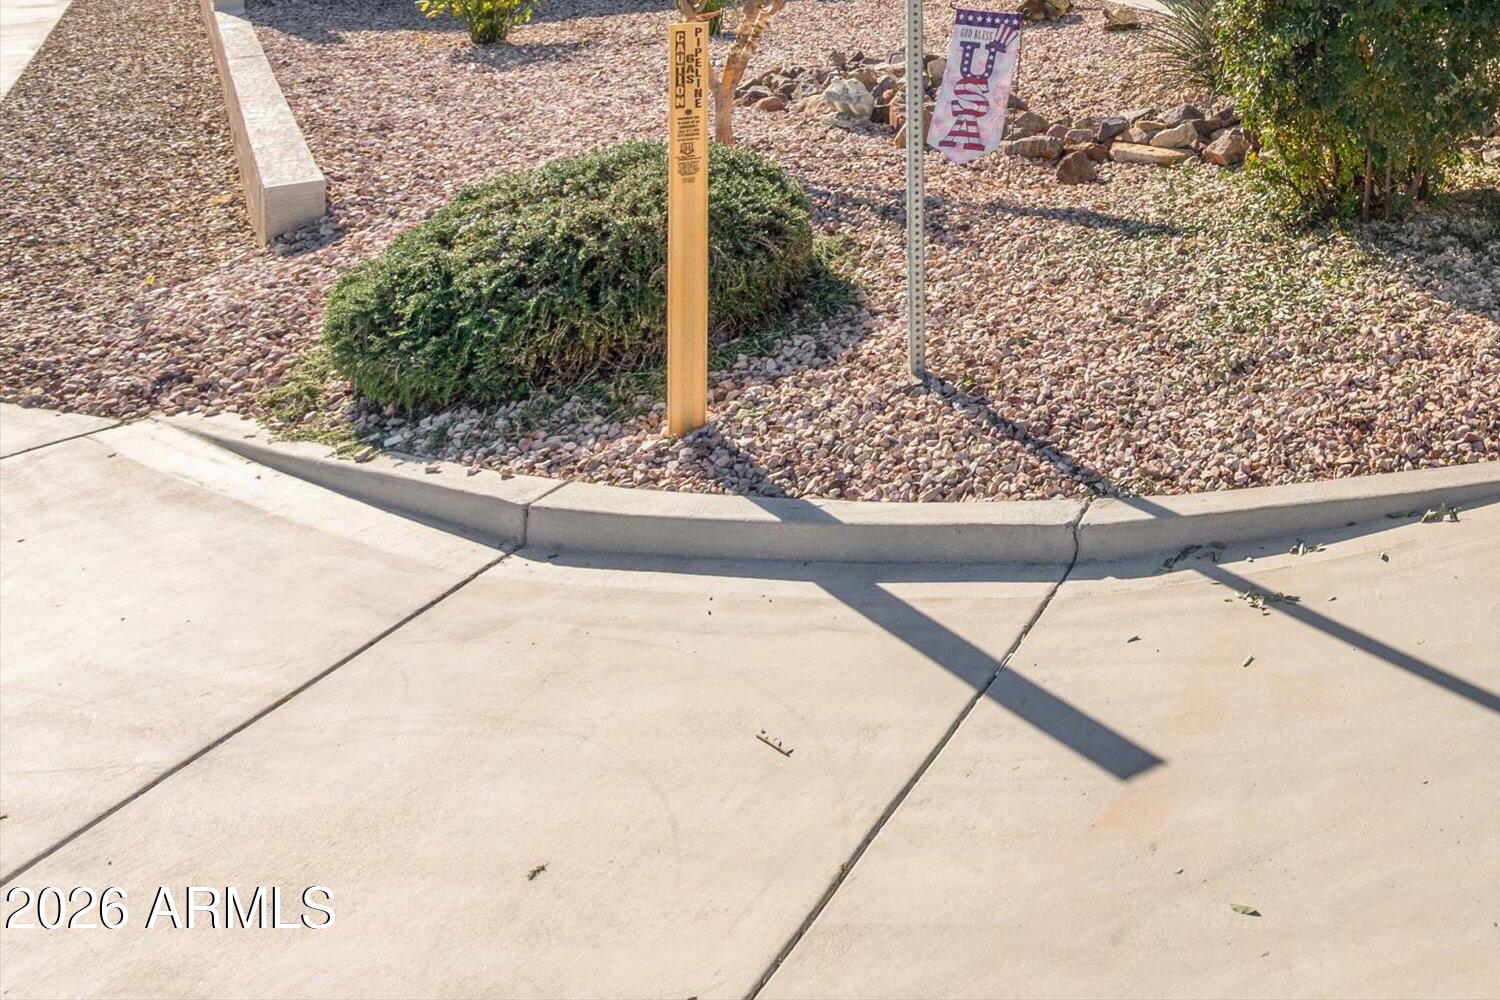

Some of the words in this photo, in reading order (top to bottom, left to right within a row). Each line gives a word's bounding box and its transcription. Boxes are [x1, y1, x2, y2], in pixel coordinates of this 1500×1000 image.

[960, 28, 973, 38] GOD
[974, 29, 993, 41] BLESS
[675, 31, 685, 108] CAUTION
[686, 54, 694, 84] GAS
[938, 41, 998, 152] USA
